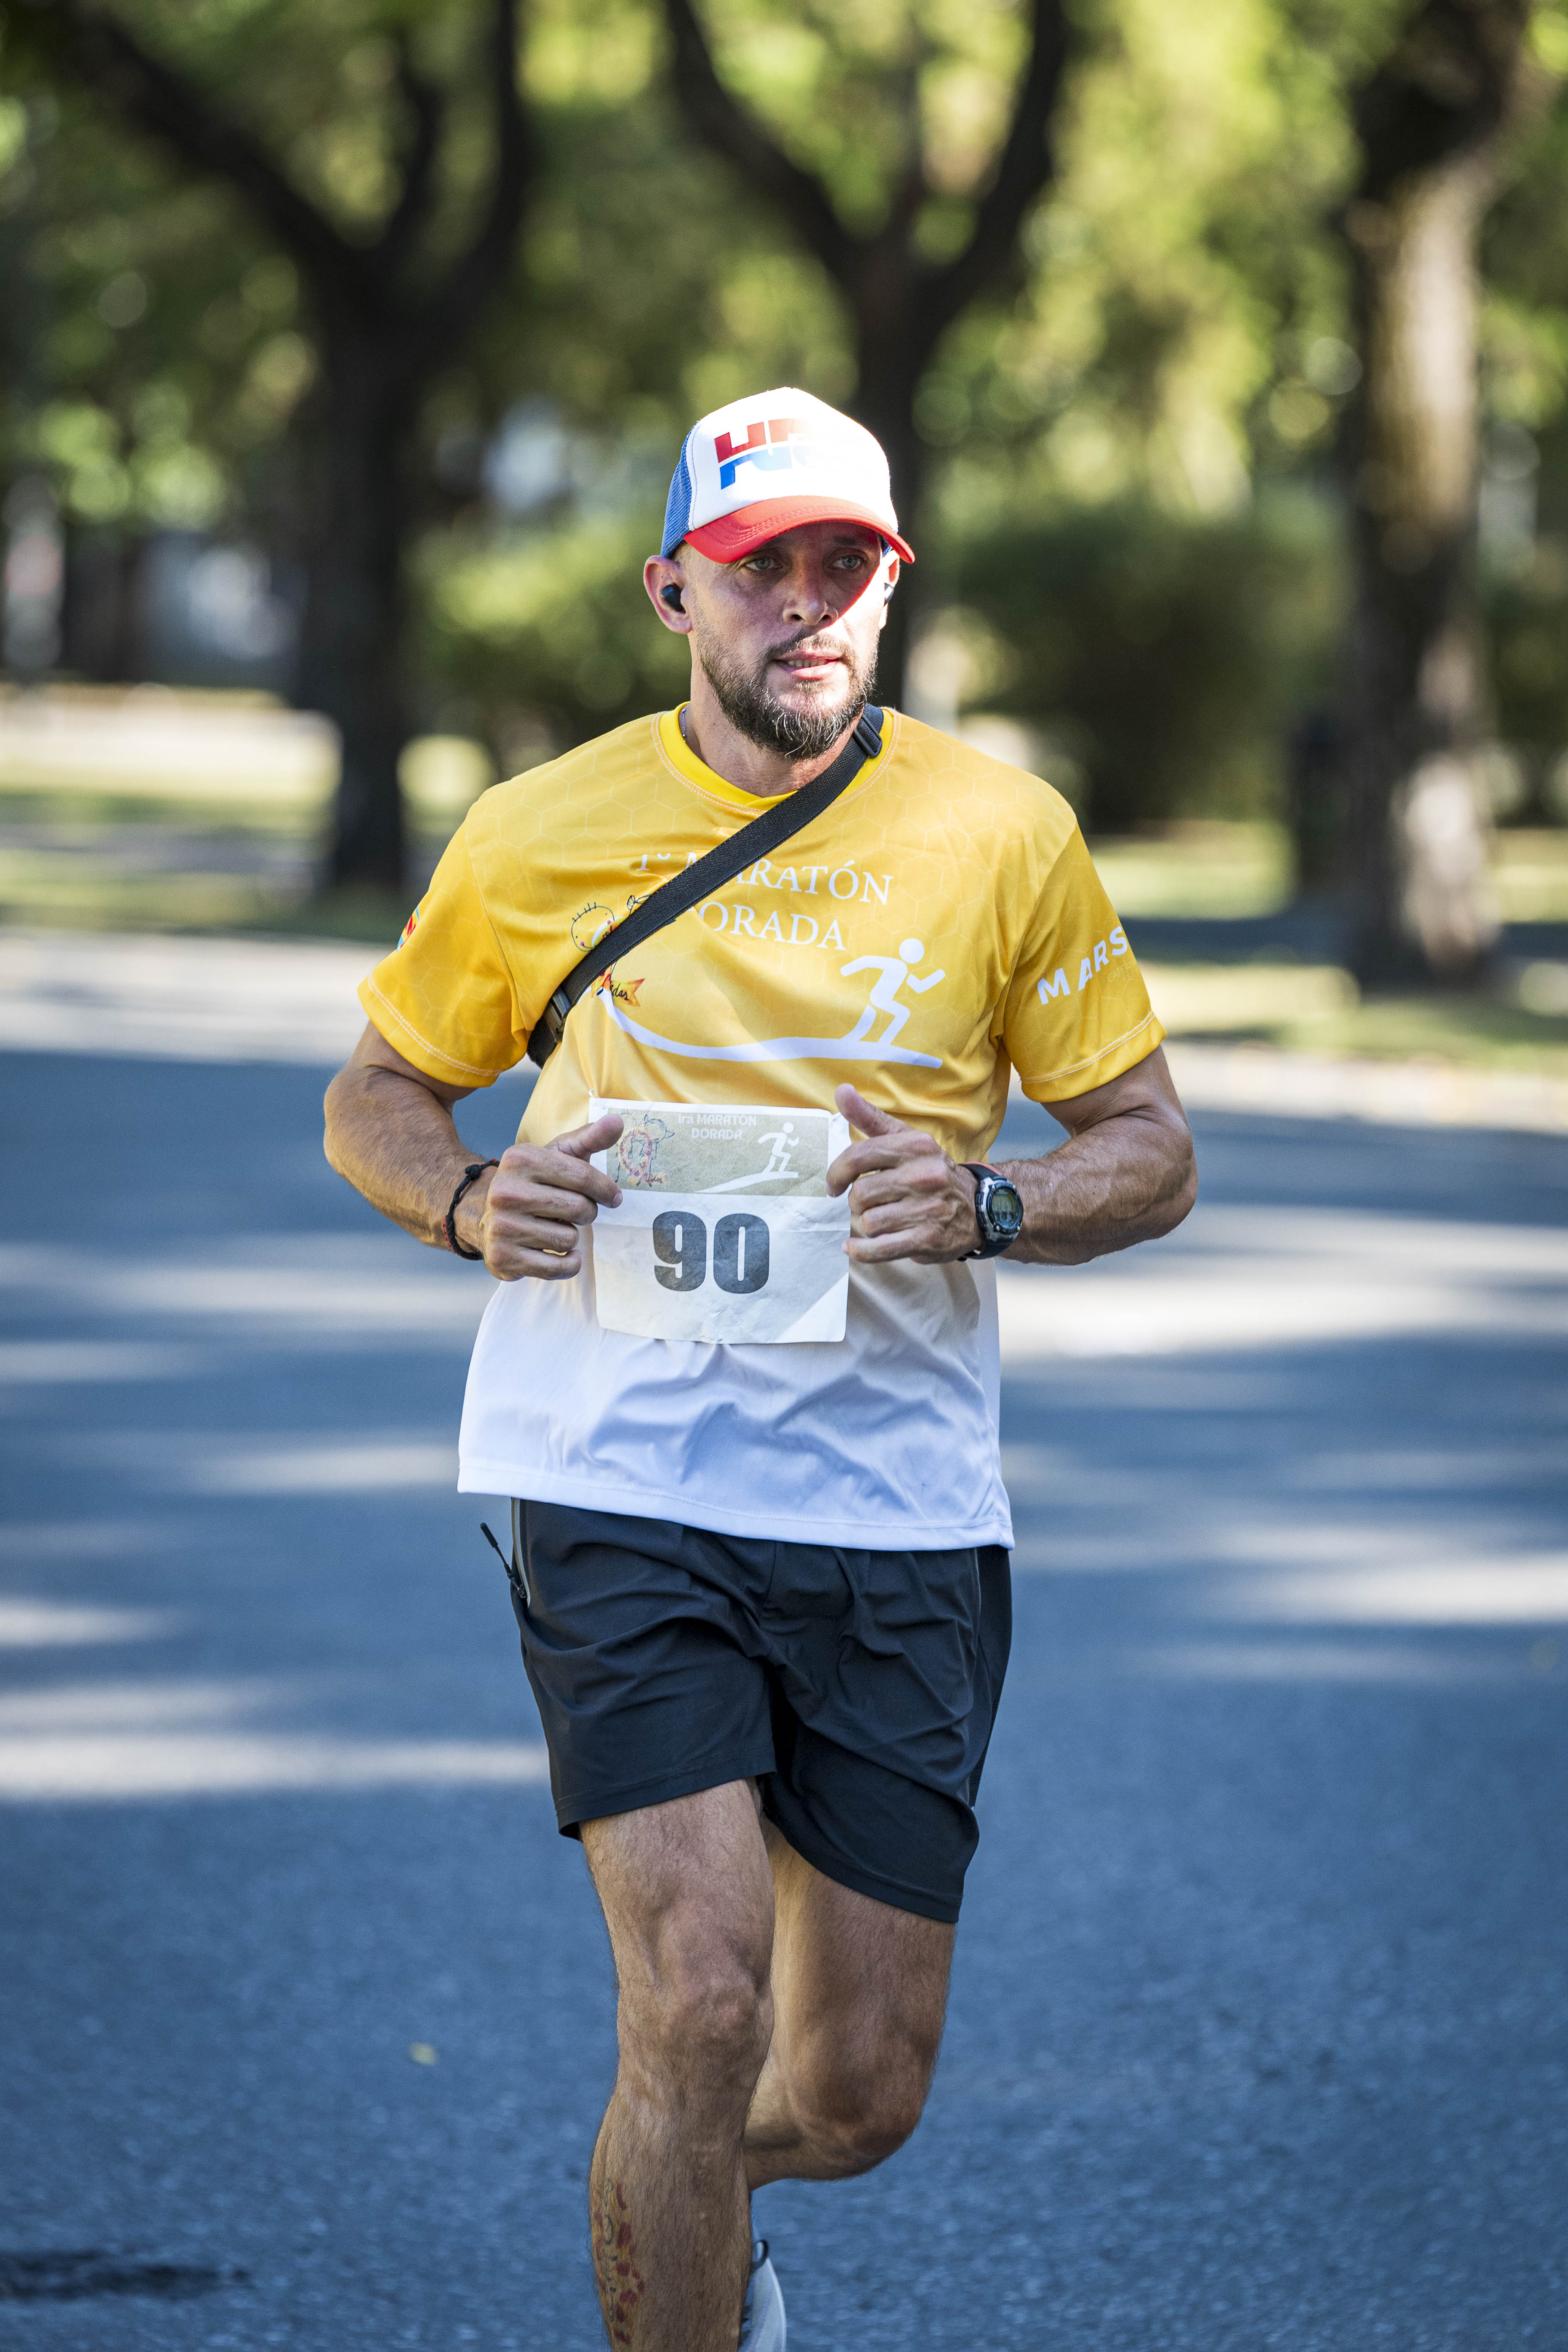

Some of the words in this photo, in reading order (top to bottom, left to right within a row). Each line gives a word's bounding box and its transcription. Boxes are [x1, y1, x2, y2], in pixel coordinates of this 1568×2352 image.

[685, 852, 894, 905] RATÓN
[687, 901, 846, 950] ORADA
[1037, 926, 1128, 1005] MARS
[692, 1128, 742, 1140] DORADA
[653, 1211, 770, 1294] 90
